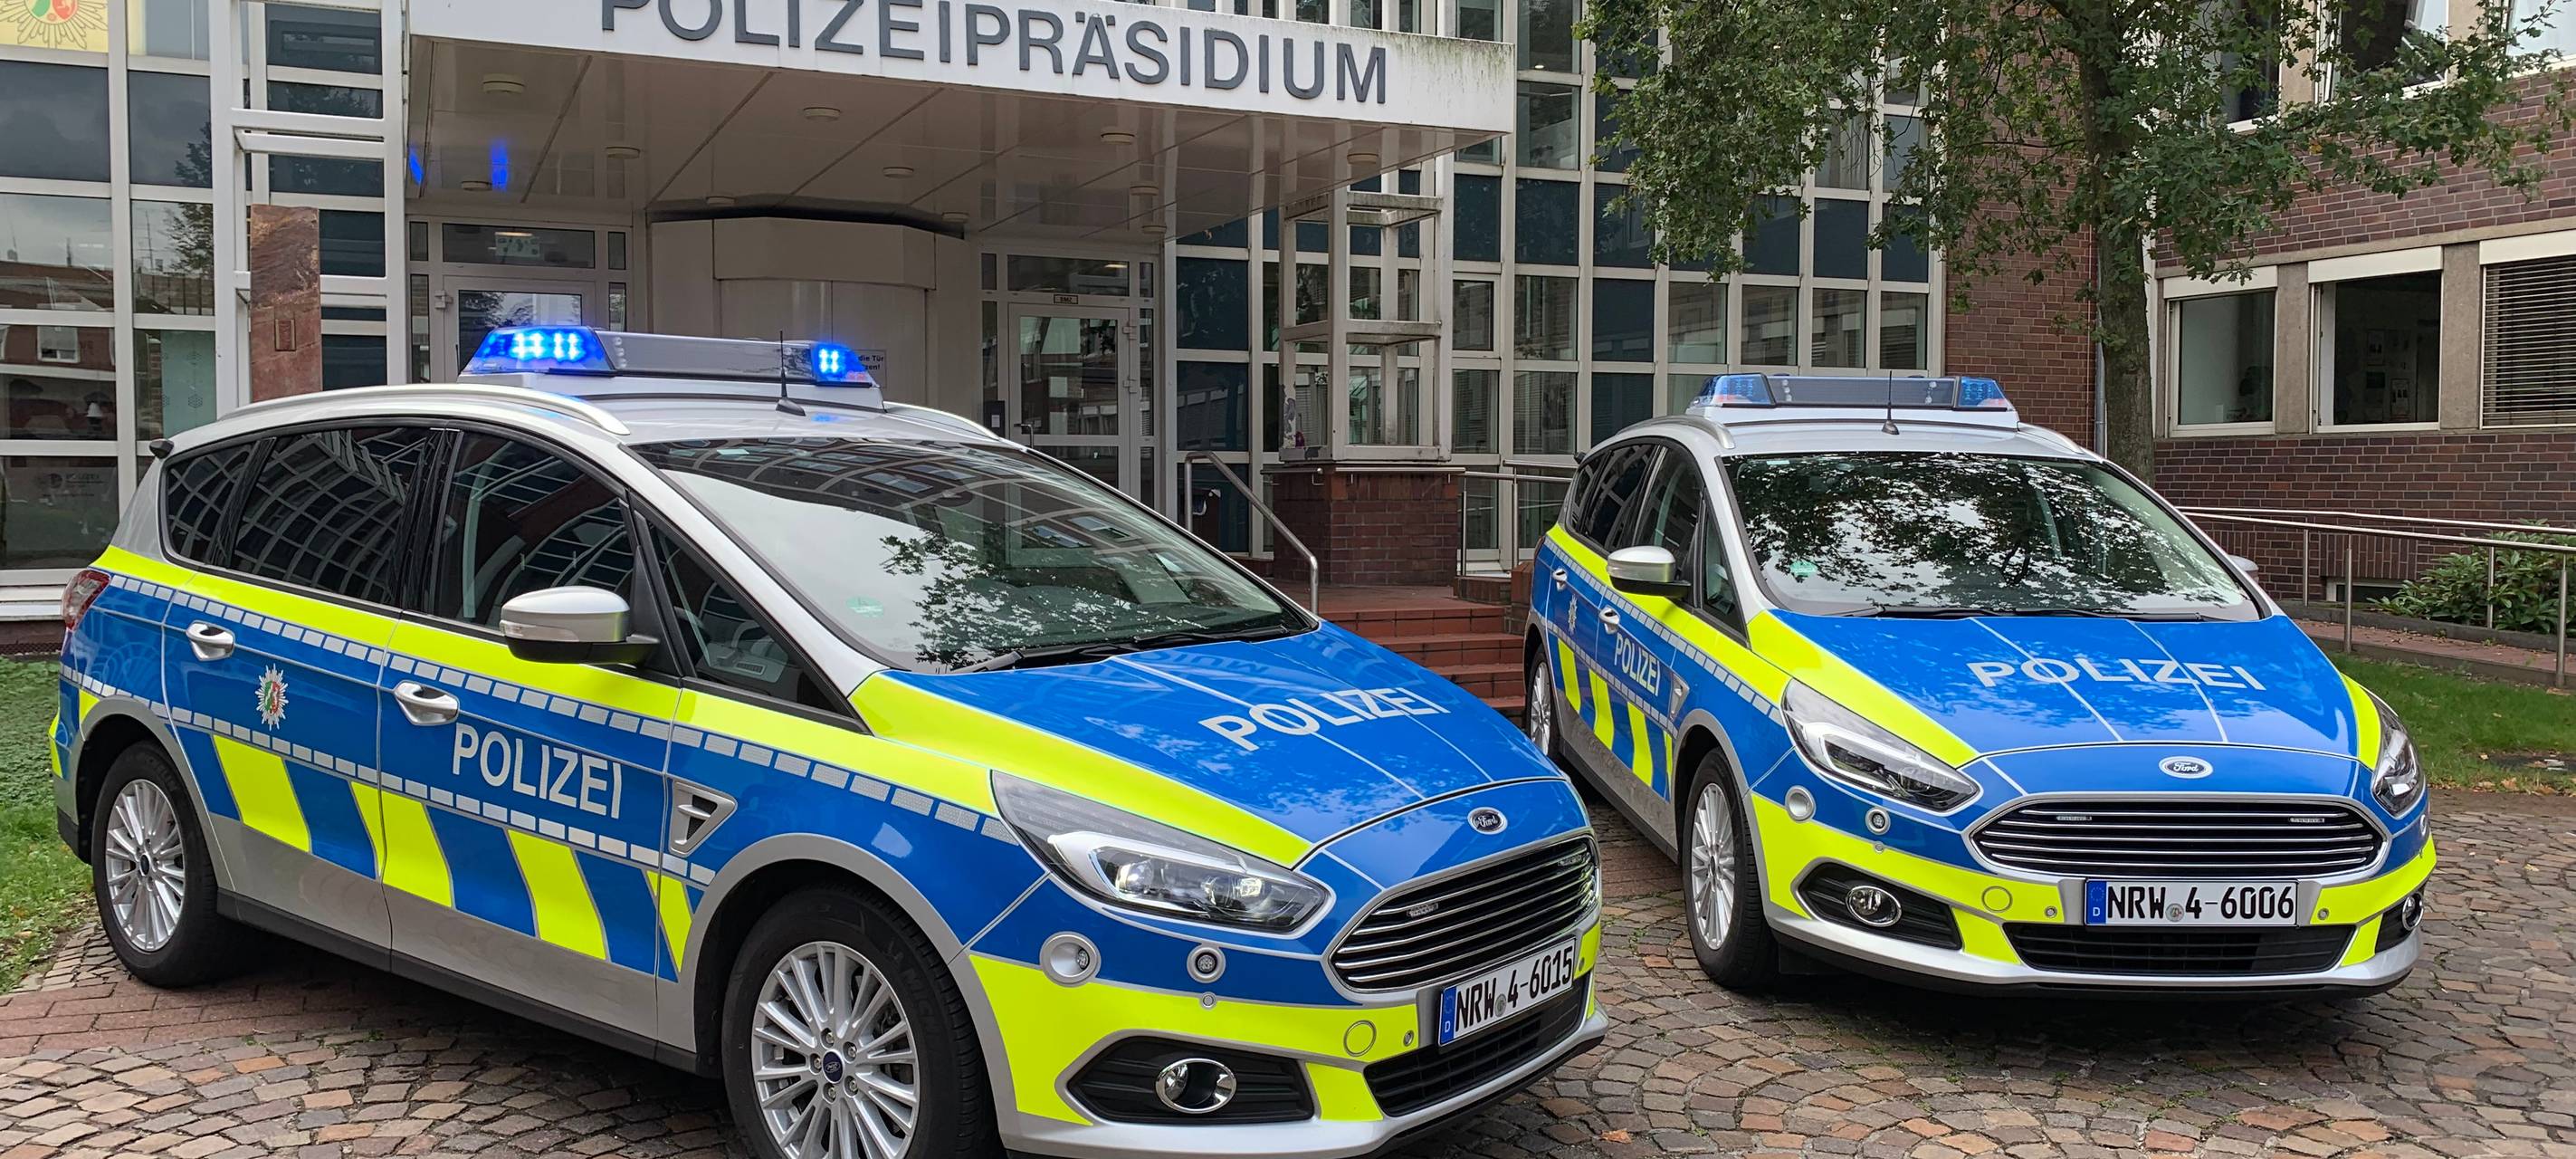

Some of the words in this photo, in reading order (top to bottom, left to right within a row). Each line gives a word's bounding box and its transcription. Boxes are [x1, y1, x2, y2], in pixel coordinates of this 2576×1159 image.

[1614, 632, 1661, 697] POLIZEI
[1966, 657, 2266, 691] POLIZEI
[1197, 687, 1451, 752] POLIZEI
[453, 722, 622, 819] POLIZEI
[2173, 761, 2199, 772] Ford
[1476, 815, 1499, 828] Ford
[2092, 907, 2101, 916] D
[2107, 886, 2166, 919] NRW
[2185, 886, 2295, 919] 4-6006
[1455, 977, 1497, 1032] NRW
[1507, 945, 1573, 1008] 4-6015
[1444, 1020, 1451, 1033] D
